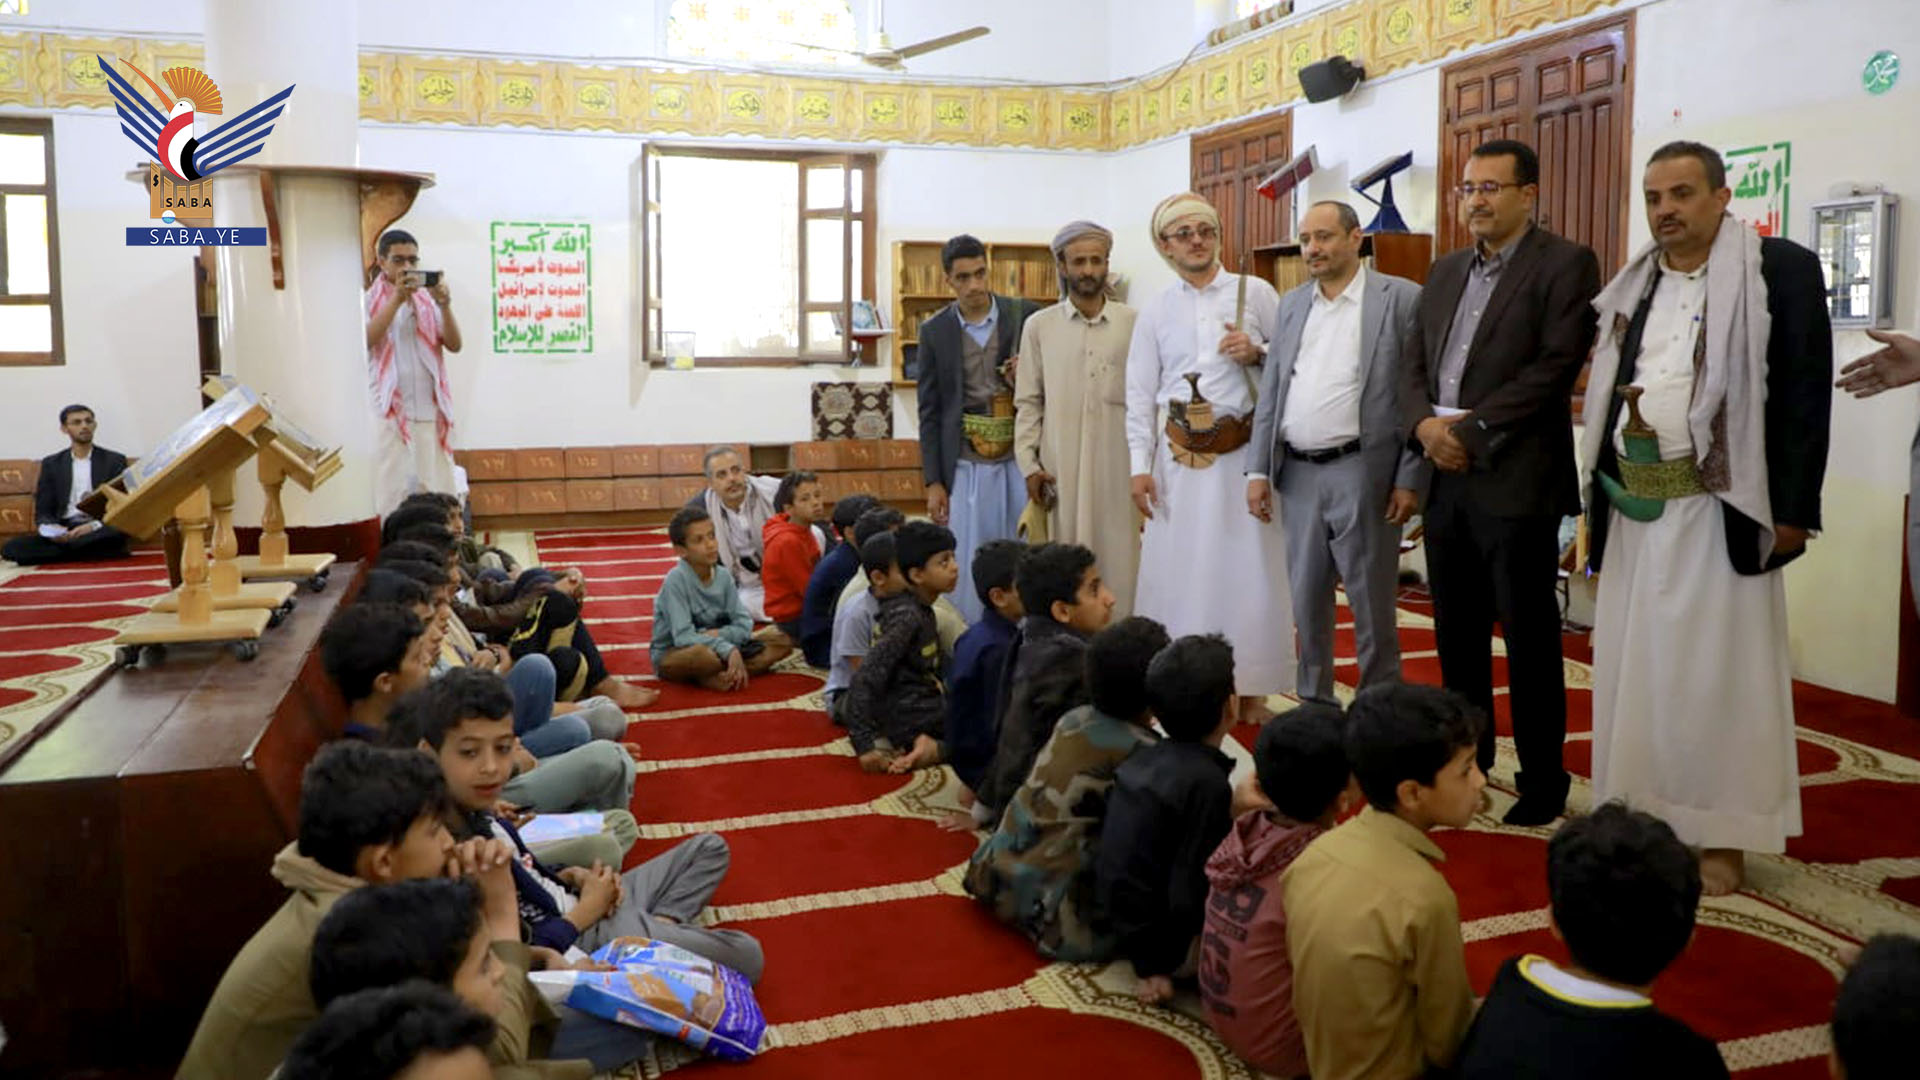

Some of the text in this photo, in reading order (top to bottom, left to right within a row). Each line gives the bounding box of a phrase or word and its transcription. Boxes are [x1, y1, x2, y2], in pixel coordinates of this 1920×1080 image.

[1734, 157, 1782, 198] الله
[552, 231, 585, 252] الله
[547, 322, 587, 346] النصر
